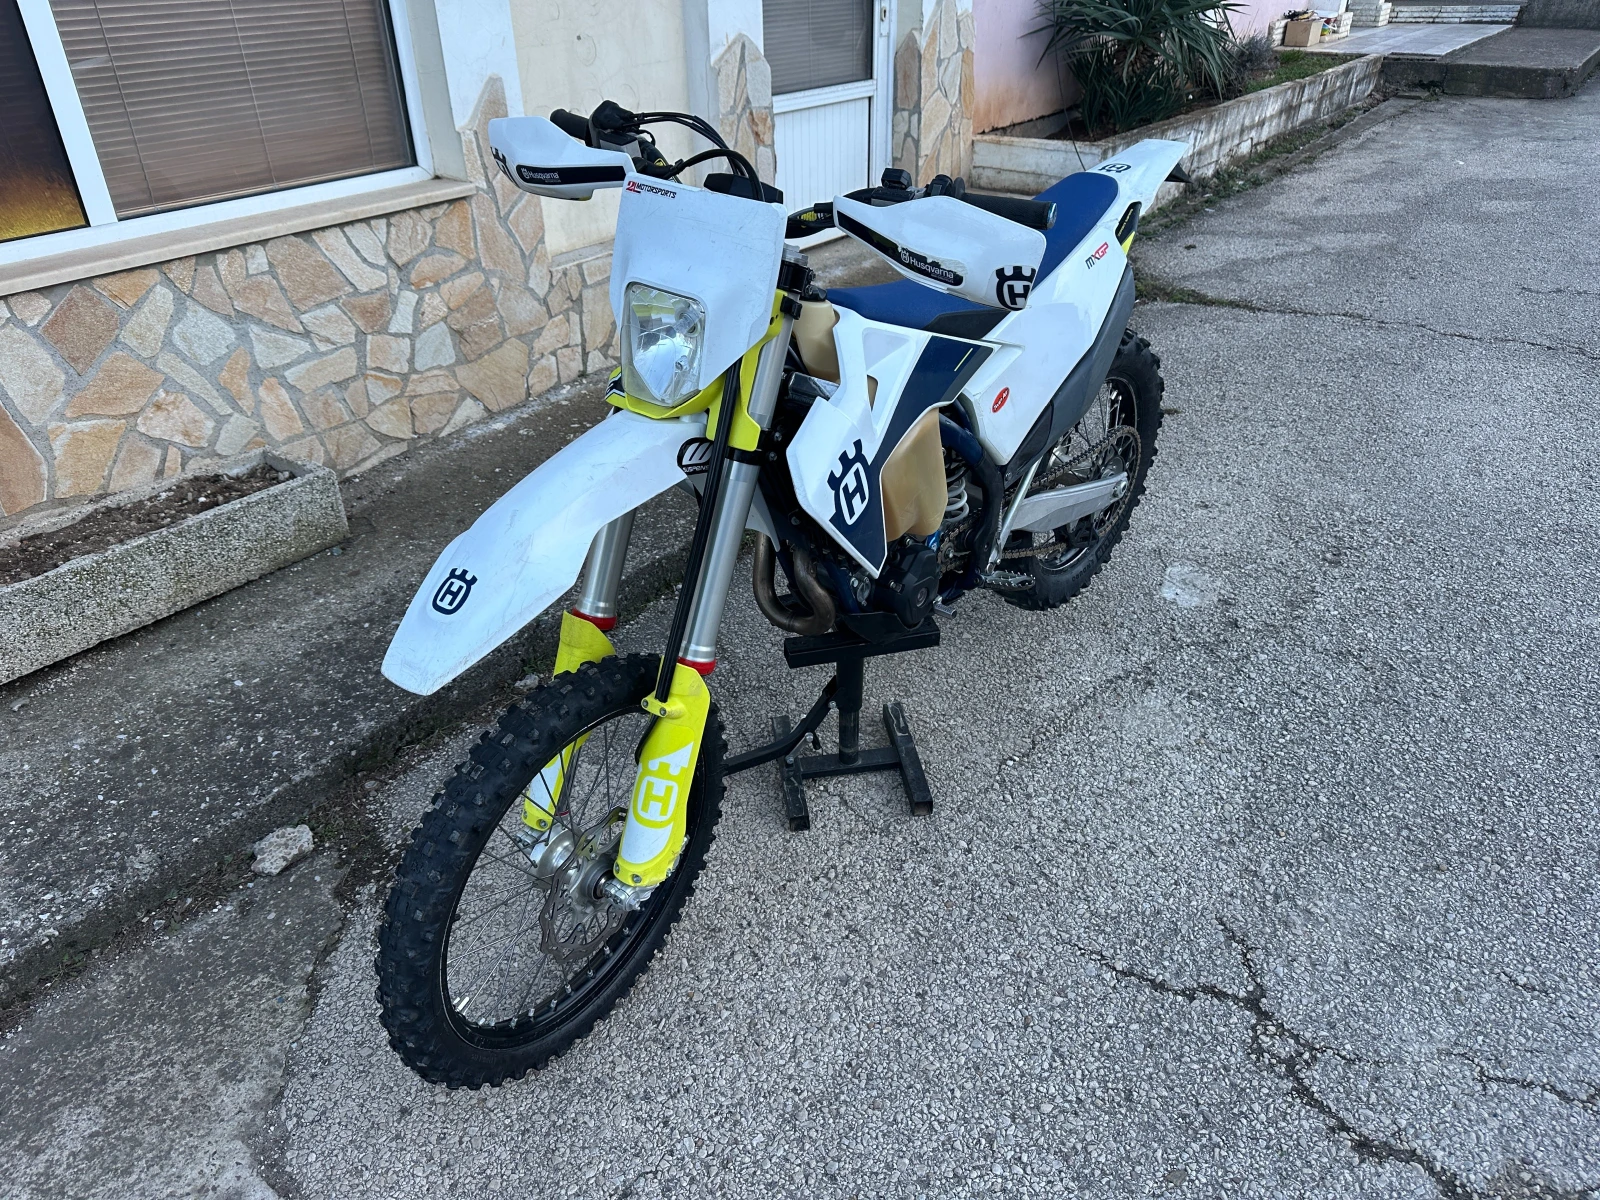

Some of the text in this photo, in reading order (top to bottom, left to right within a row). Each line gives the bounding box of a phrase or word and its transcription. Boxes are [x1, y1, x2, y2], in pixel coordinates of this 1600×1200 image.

[529, 171, 560, 180] Husqvarna
[636, 183, 677, 199] MOTORSPORTS
[910, 256, 954, 279] Husqvarna
